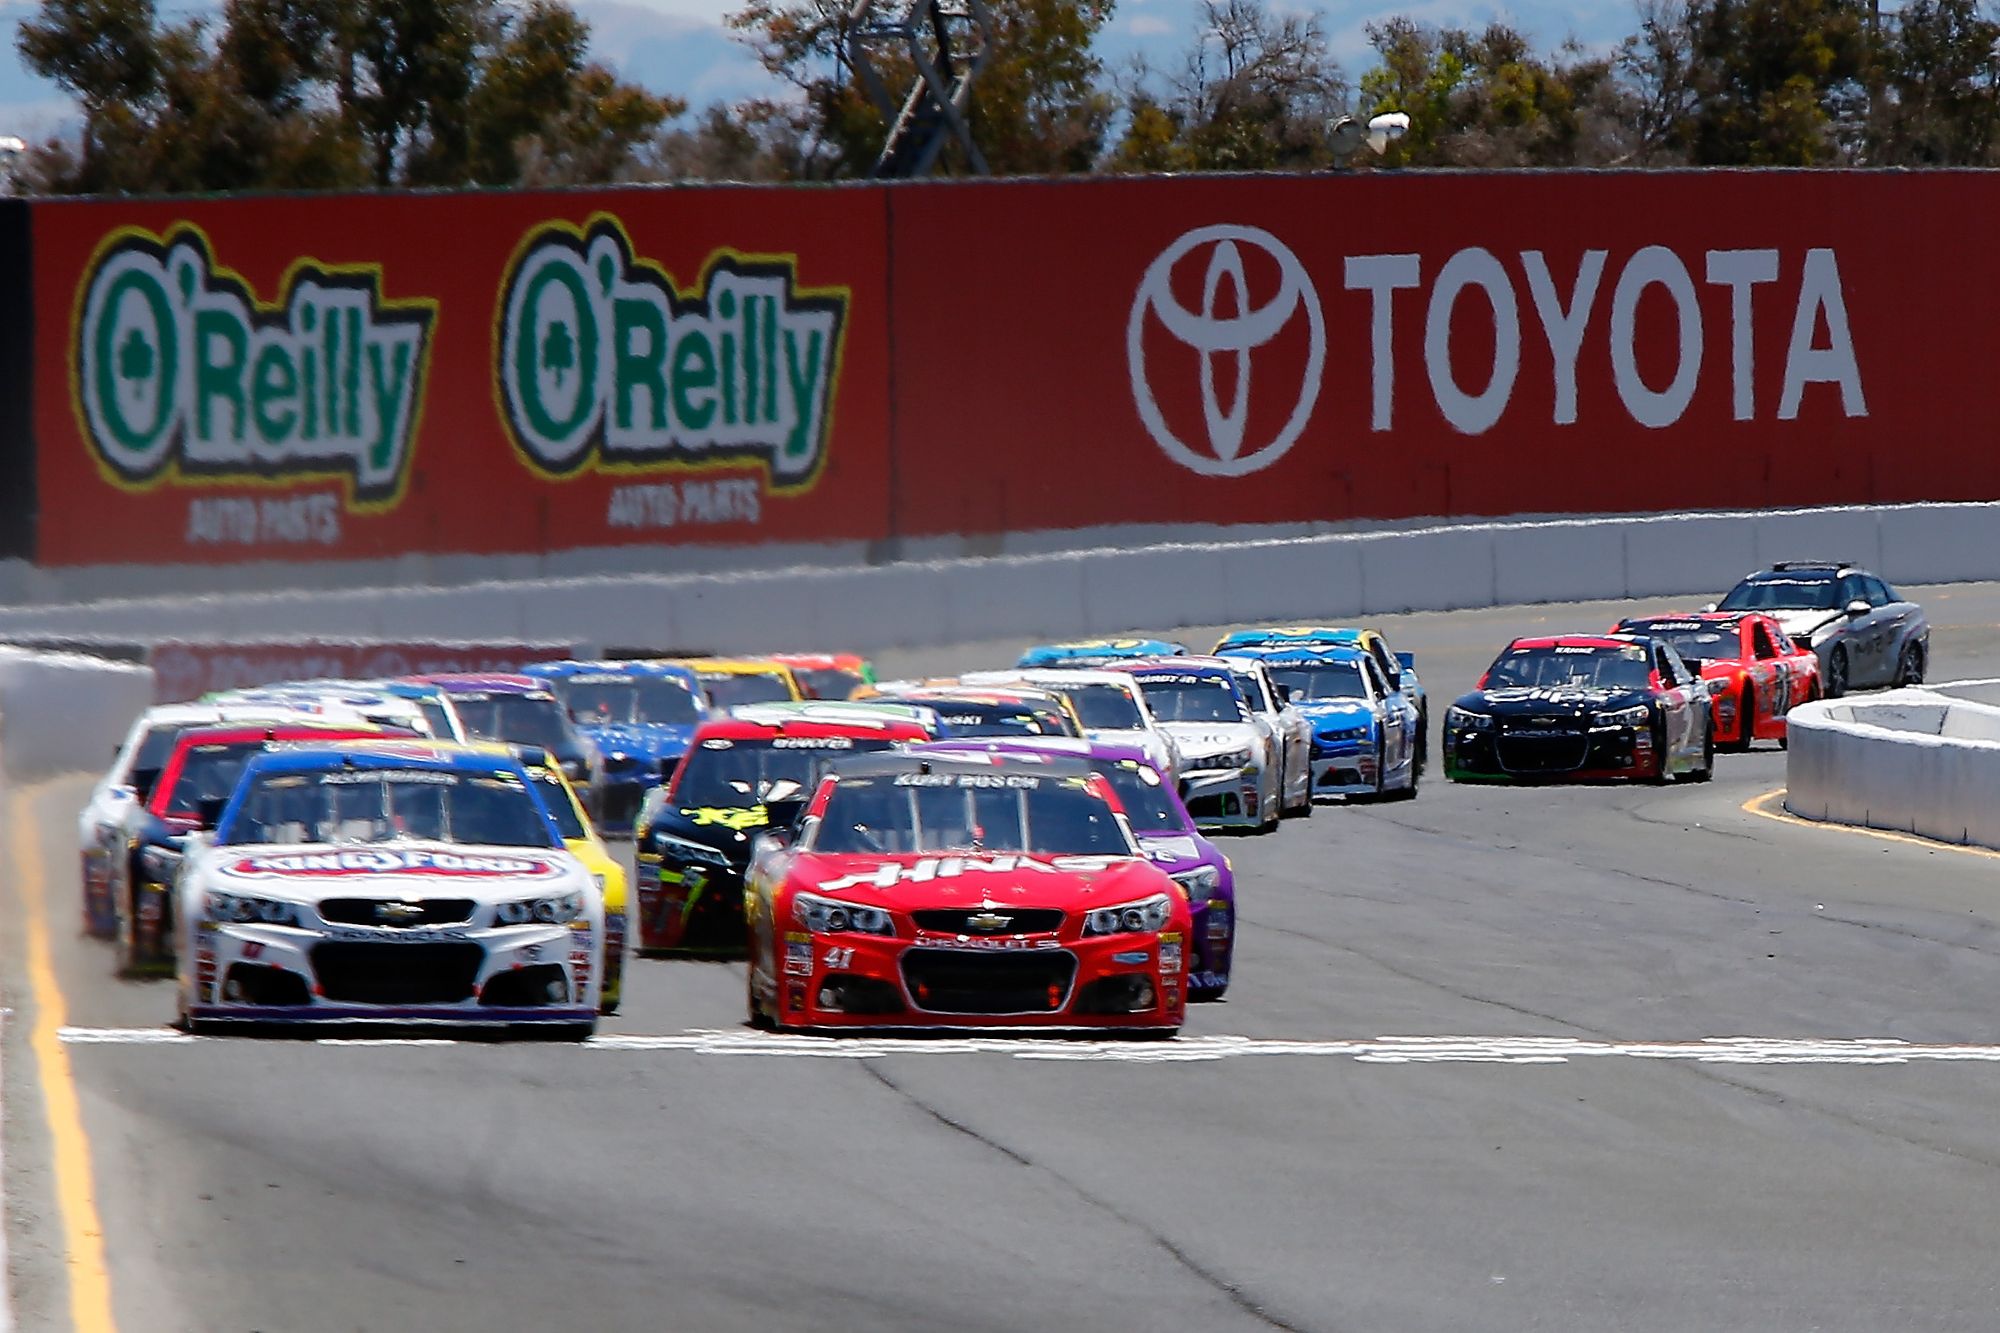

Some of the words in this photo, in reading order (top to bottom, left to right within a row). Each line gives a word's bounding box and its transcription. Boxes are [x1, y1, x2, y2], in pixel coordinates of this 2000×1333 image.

[91, 256, 415, 472] O'Reilly
[512, 245, 826, 460] O'Reilly
[1344, 245, 1869, 435] TOYOTA
[607, 484, 675, 528] AUTO
[681, 479, 760, 524] PARTS
[957, 774, 1041, 789] BUSCH
[822, 946, 857, 969] 41
